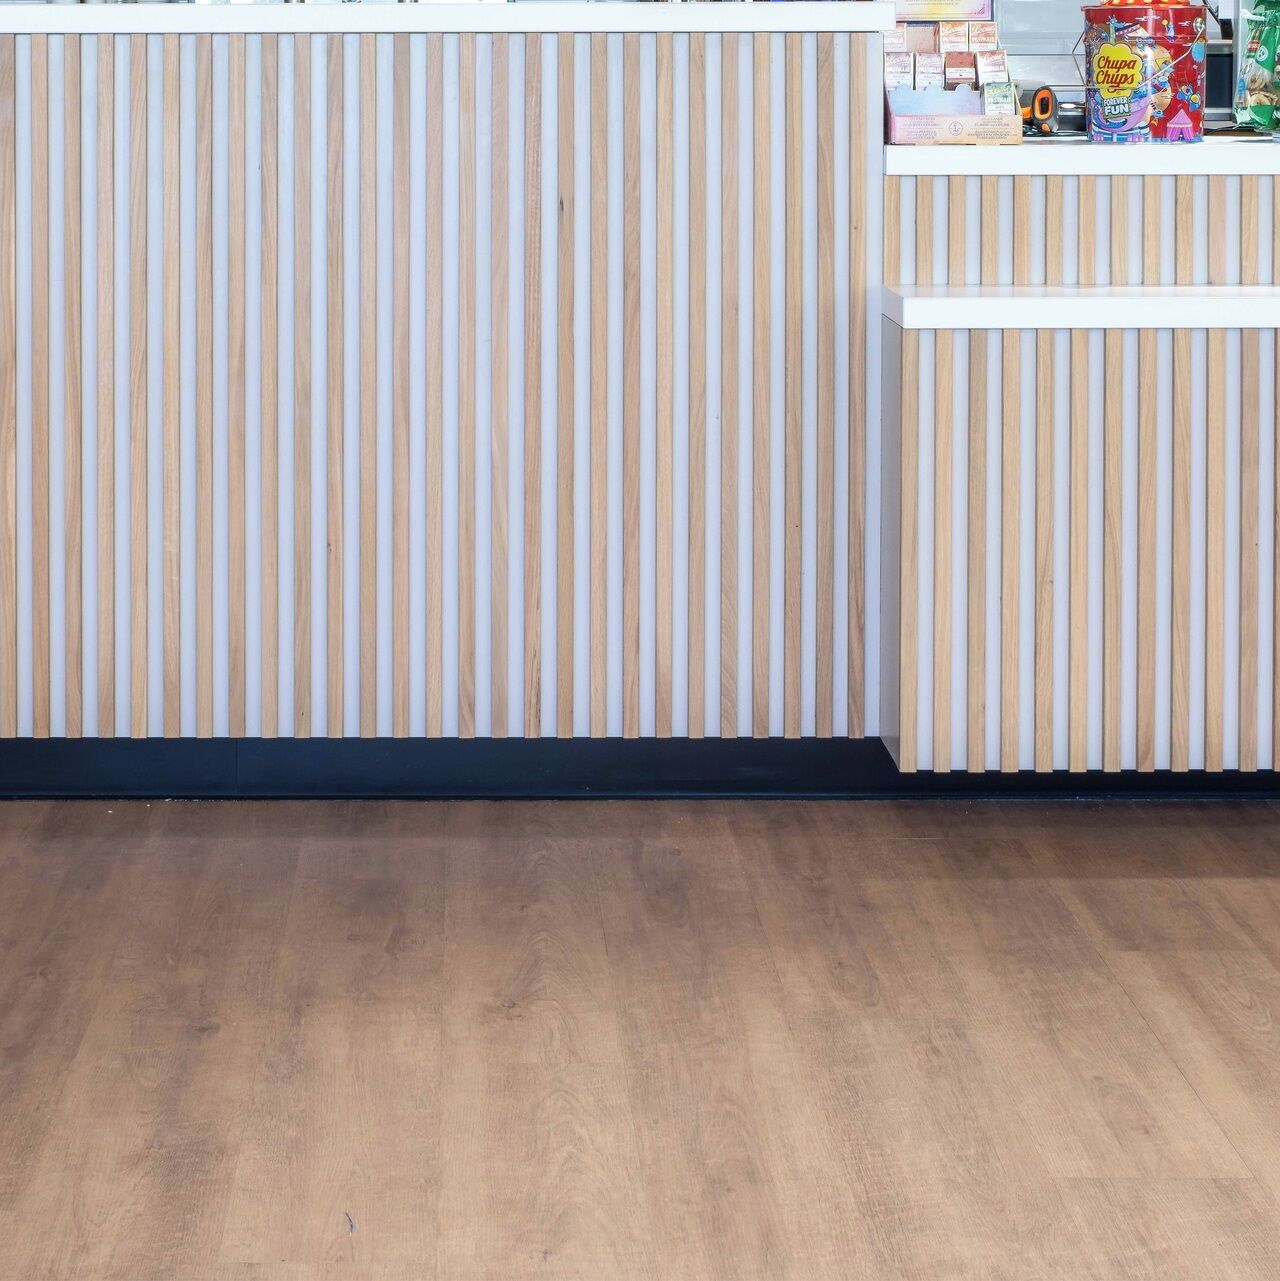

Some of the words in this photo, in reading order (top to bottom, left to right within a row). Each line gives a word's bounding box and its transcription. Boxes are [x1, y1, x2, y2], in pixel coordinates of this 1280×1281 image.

[1097, 55, 1138, 73] Chupa
[1096, 69, 1136, 87] Chups
[1103, 97, 1128, 106] FOREVER
[1104, 103, 1129, 116] FUN
